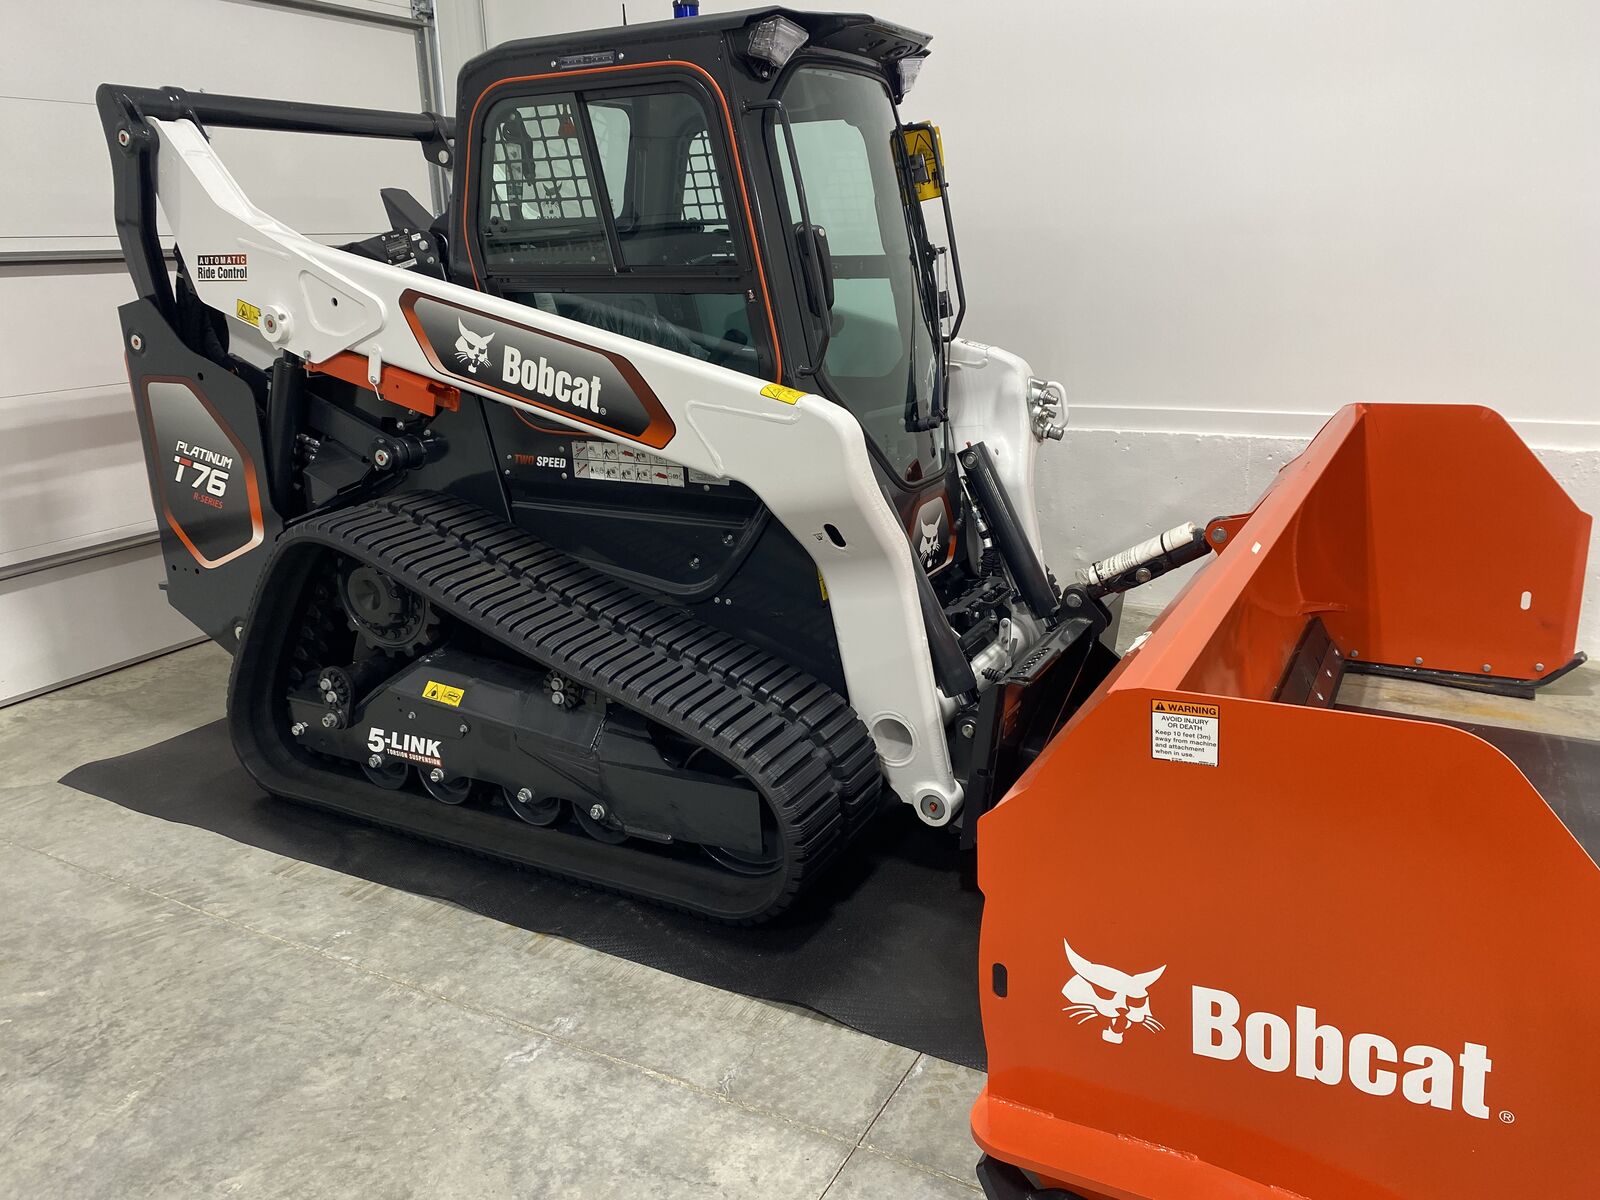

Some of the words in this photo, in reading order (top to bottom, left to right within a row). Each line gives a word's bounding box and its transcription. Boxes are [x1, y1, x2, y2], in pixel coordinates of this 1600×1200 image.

[199, 256, 246, 265] AUTOMATIC
[198, 267, 216, 279] Ride
[218, 266, 247, 279] Control
[502, 345, 601, 414] Bobcat
[175, 440, 233, 470] PLATINUM
[515, 454, 534, 464] TWO
[536, 456, 566, 468] SPEED
[173, 455, 230, 497] T76
[193, 491, 223, 509] R-SERIES
[1168, 703, 1216, 716] WARNING
[1161, 715, 1182, 723] AVOID
[1183, 717, 1209, 725] INJURY
[1179, 723, 1203, 731] DEATH
[367, 727, 442, 759] 5-LINK
[1197, 733, 1211, 741] (3m)
[1169, 744, 1205, 752] attachment
[387, 748, 408, 759] TORSION
[409, 753, 441, 766] SUSPENSION
[1192, 985, 1492, 1120] Bobcat
